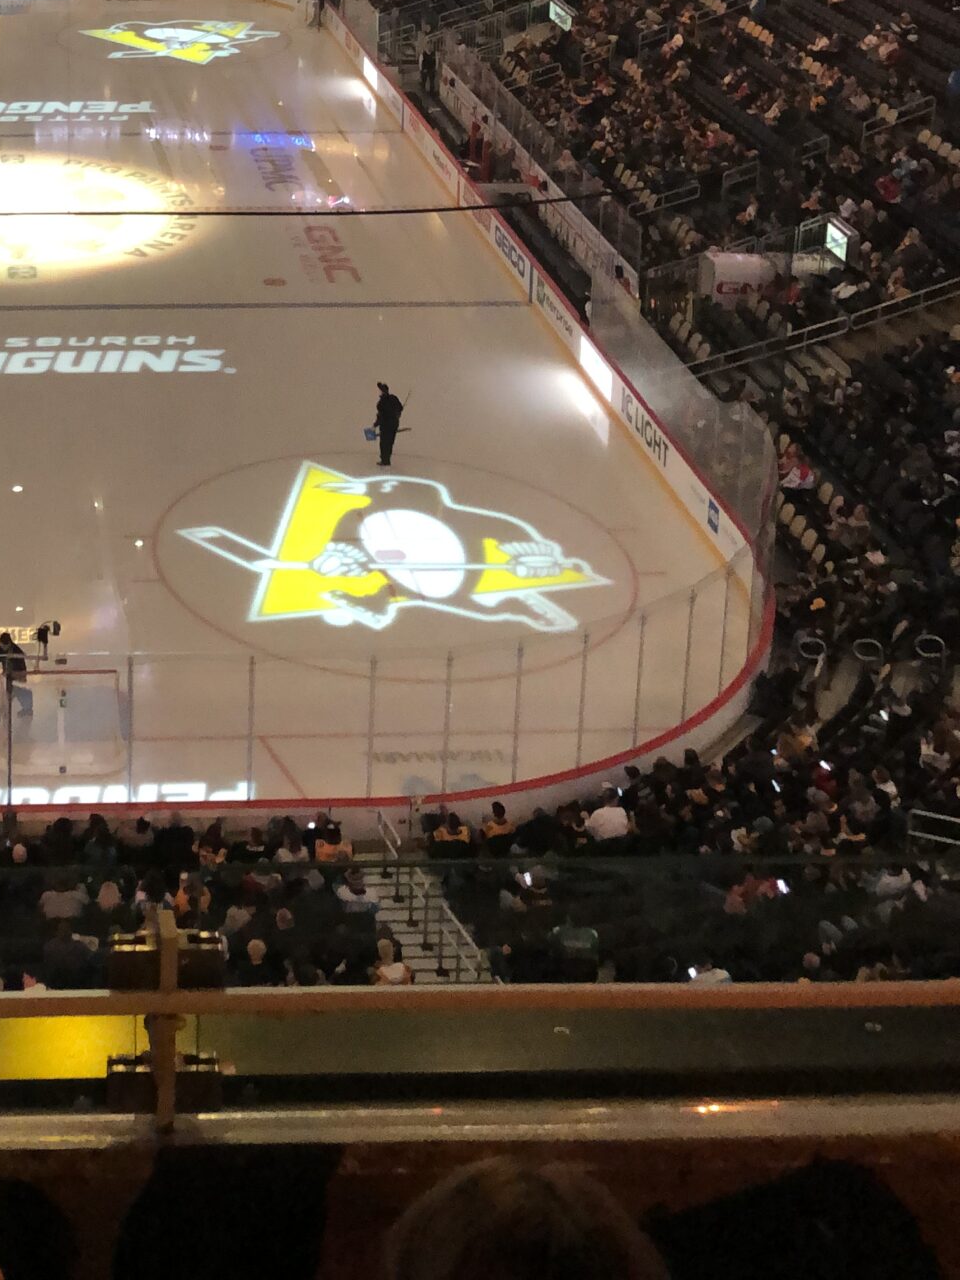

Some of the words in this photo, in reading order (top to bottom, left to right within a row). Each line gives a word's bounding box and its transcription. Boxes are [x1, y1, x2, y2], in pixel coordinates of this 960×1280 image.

[495, 224, 525, 278] GEICO
[621, 387, 633, 423] IC
[635, 407, 669, 468] LIGHT
